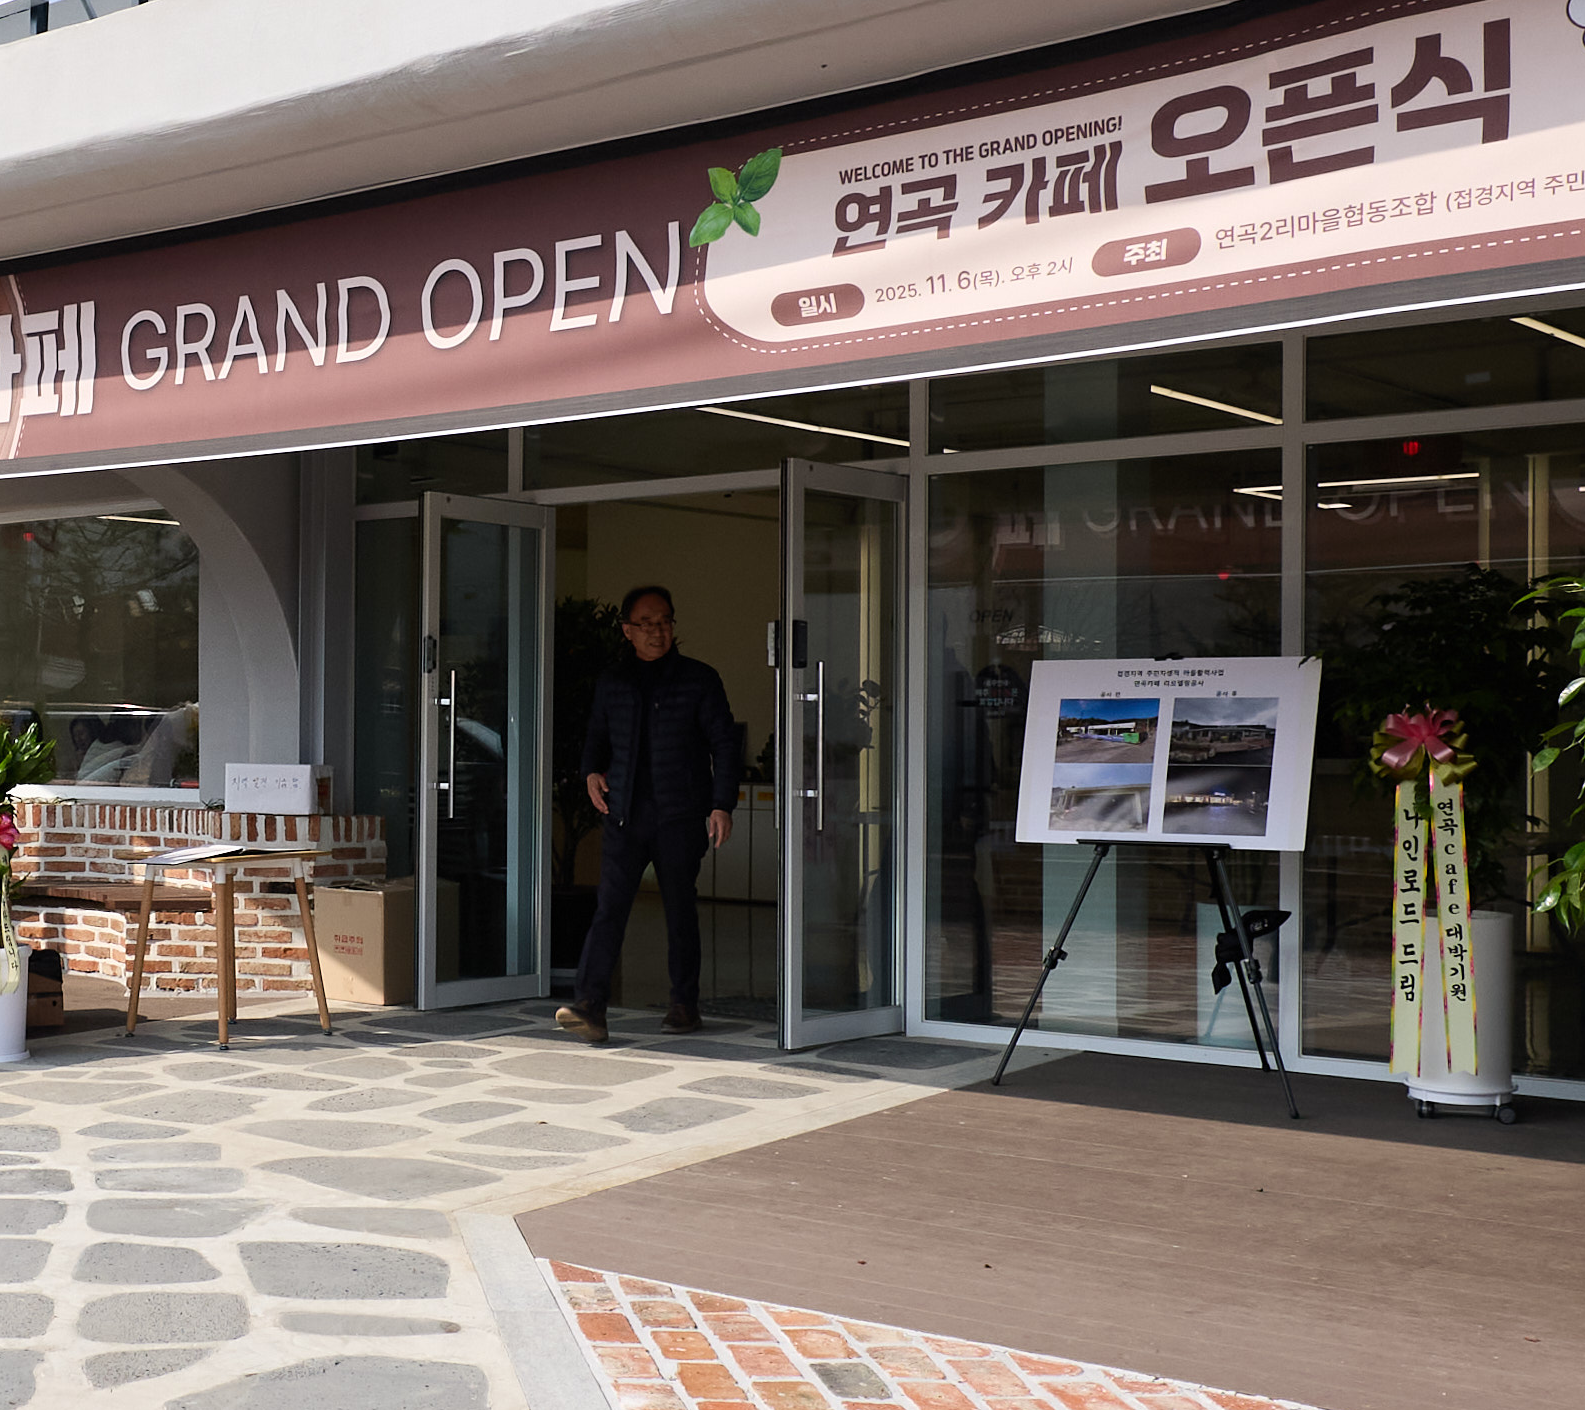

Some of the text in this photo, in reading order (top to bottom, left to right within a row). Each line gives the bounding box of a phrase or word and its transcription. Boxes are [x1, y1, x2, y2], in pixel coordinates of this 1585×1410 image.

[832, 18, 1511, 258] 연곡 카페 오픈식
[839, 115, 1123, 185] WELCOME TO THE GRAND OPENING!
[1123, 239, 1168, 267] 주최
[1215, 191, 1437, 250] 연곡2리마을협동조합
[1445, 178, 1537, 213] (접경지역
[121, 276, 393, 391] GRAND
[420, 221, 682, 350] OPEN
[798, 292, 838, 319] 일시
[875, 283, 922, 302] 2025.
[926, 274, 952, 295] 11.
[1010, 262, 1042, 283] 오후
[1047, 256, 1073, 277] 2시
[970, 609, 1013, 623] OPEN
[1399, 809, 1423, 1002] 나인로드 드림
